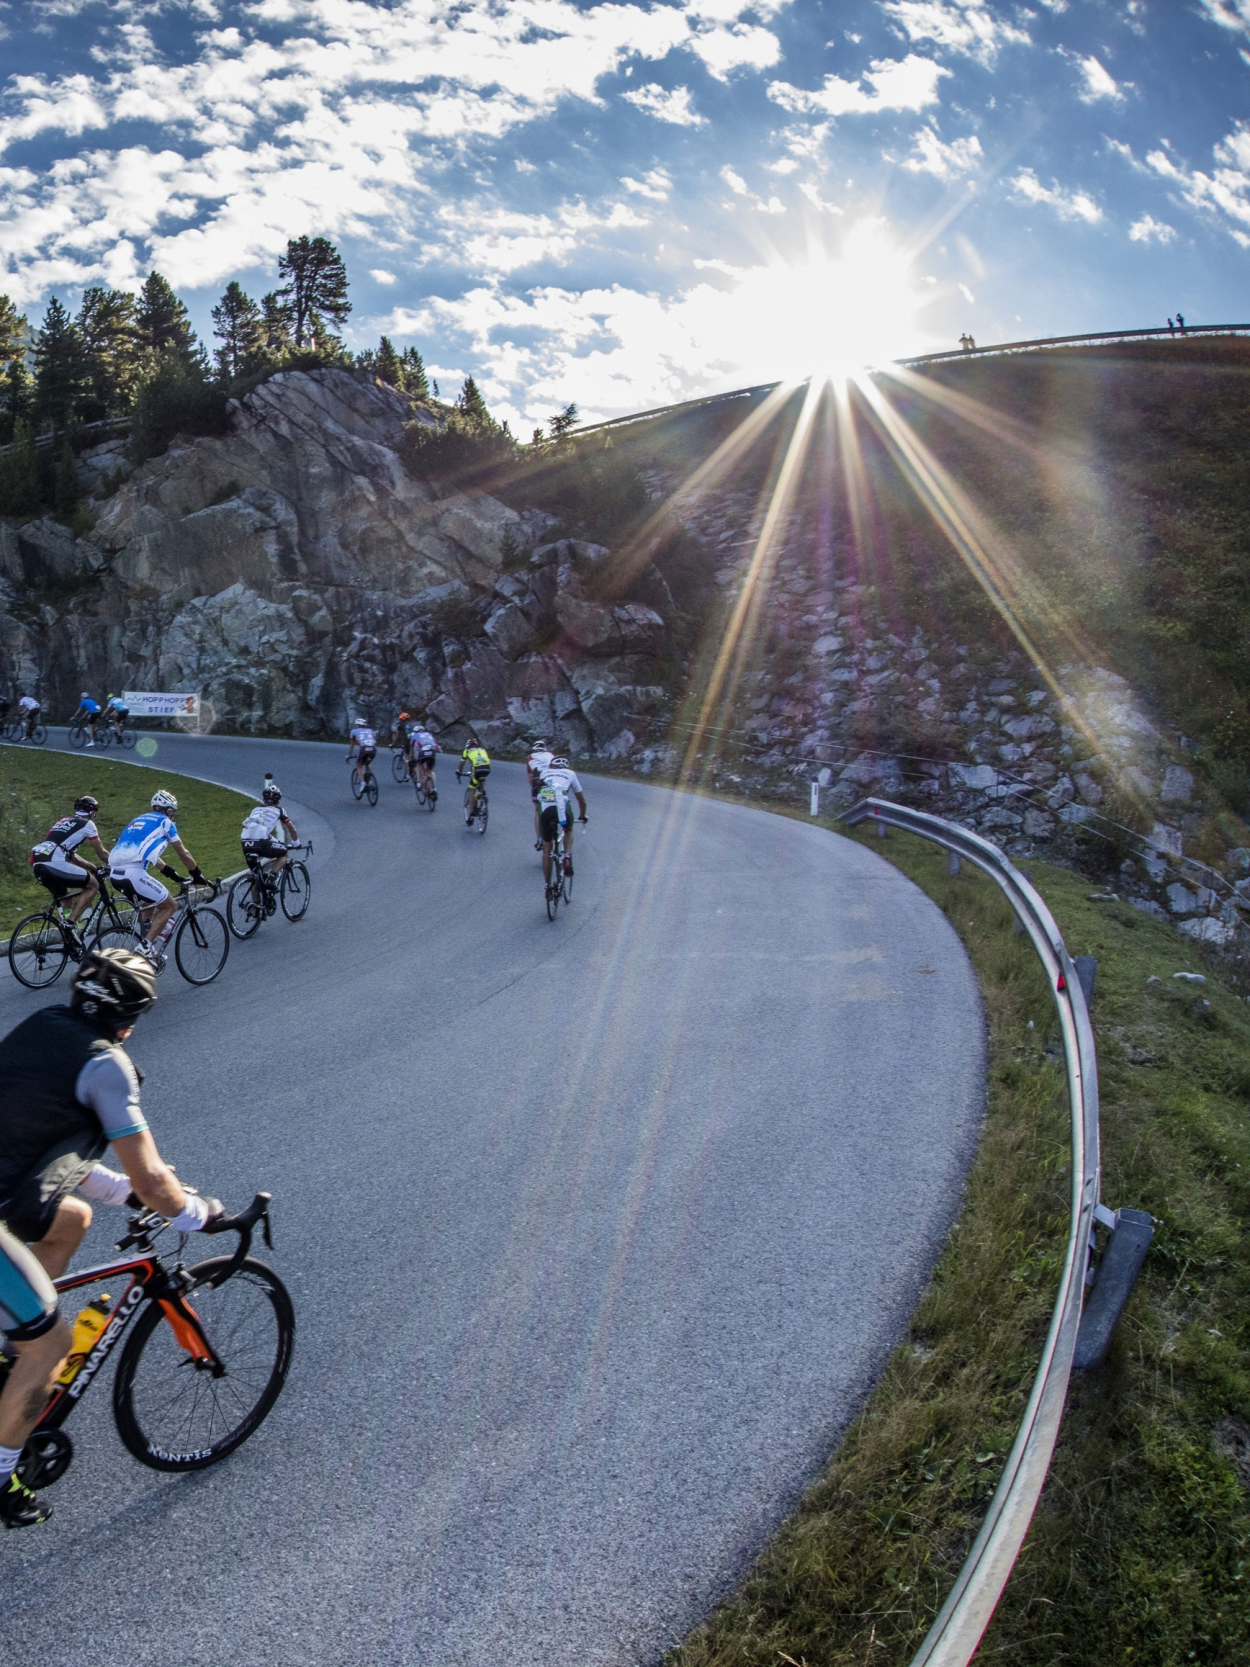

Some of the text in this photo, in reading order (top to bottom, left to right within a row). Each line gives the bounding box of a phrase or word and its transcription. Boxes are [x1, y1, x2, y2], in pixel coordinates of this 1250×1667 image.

[142, 696, 186, 704] HOPP HOPP
[67, 1285, 145, 1399] PINARELLO
